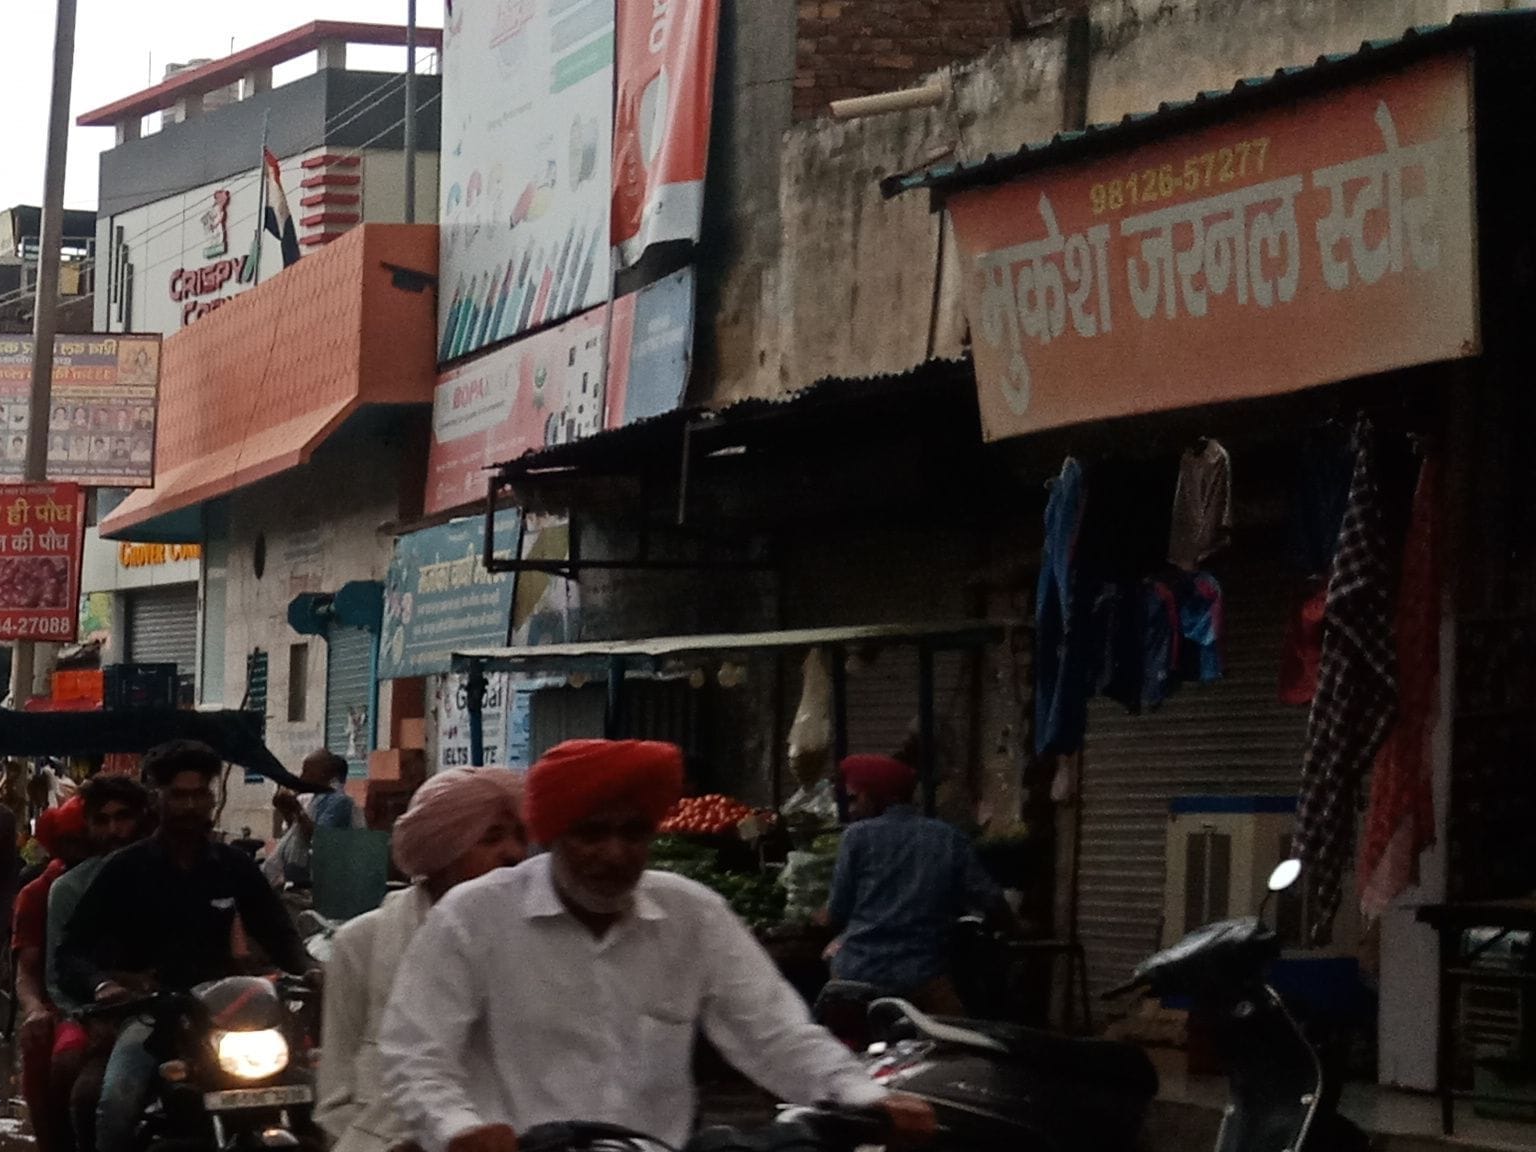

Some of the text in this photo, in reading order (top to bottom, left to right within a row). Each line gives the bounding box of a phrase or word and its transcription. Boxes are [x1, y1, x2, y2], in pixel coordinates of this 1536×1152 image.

[1090, 136, 1272, 214] 98126-57277
[168, 255, 249, 302] CRISPY
[974, 99, 1460, 416] मुकेश जरनल स्टोर
[7, 496, 31, 526] ही
[11, 527, 35, 552] की
